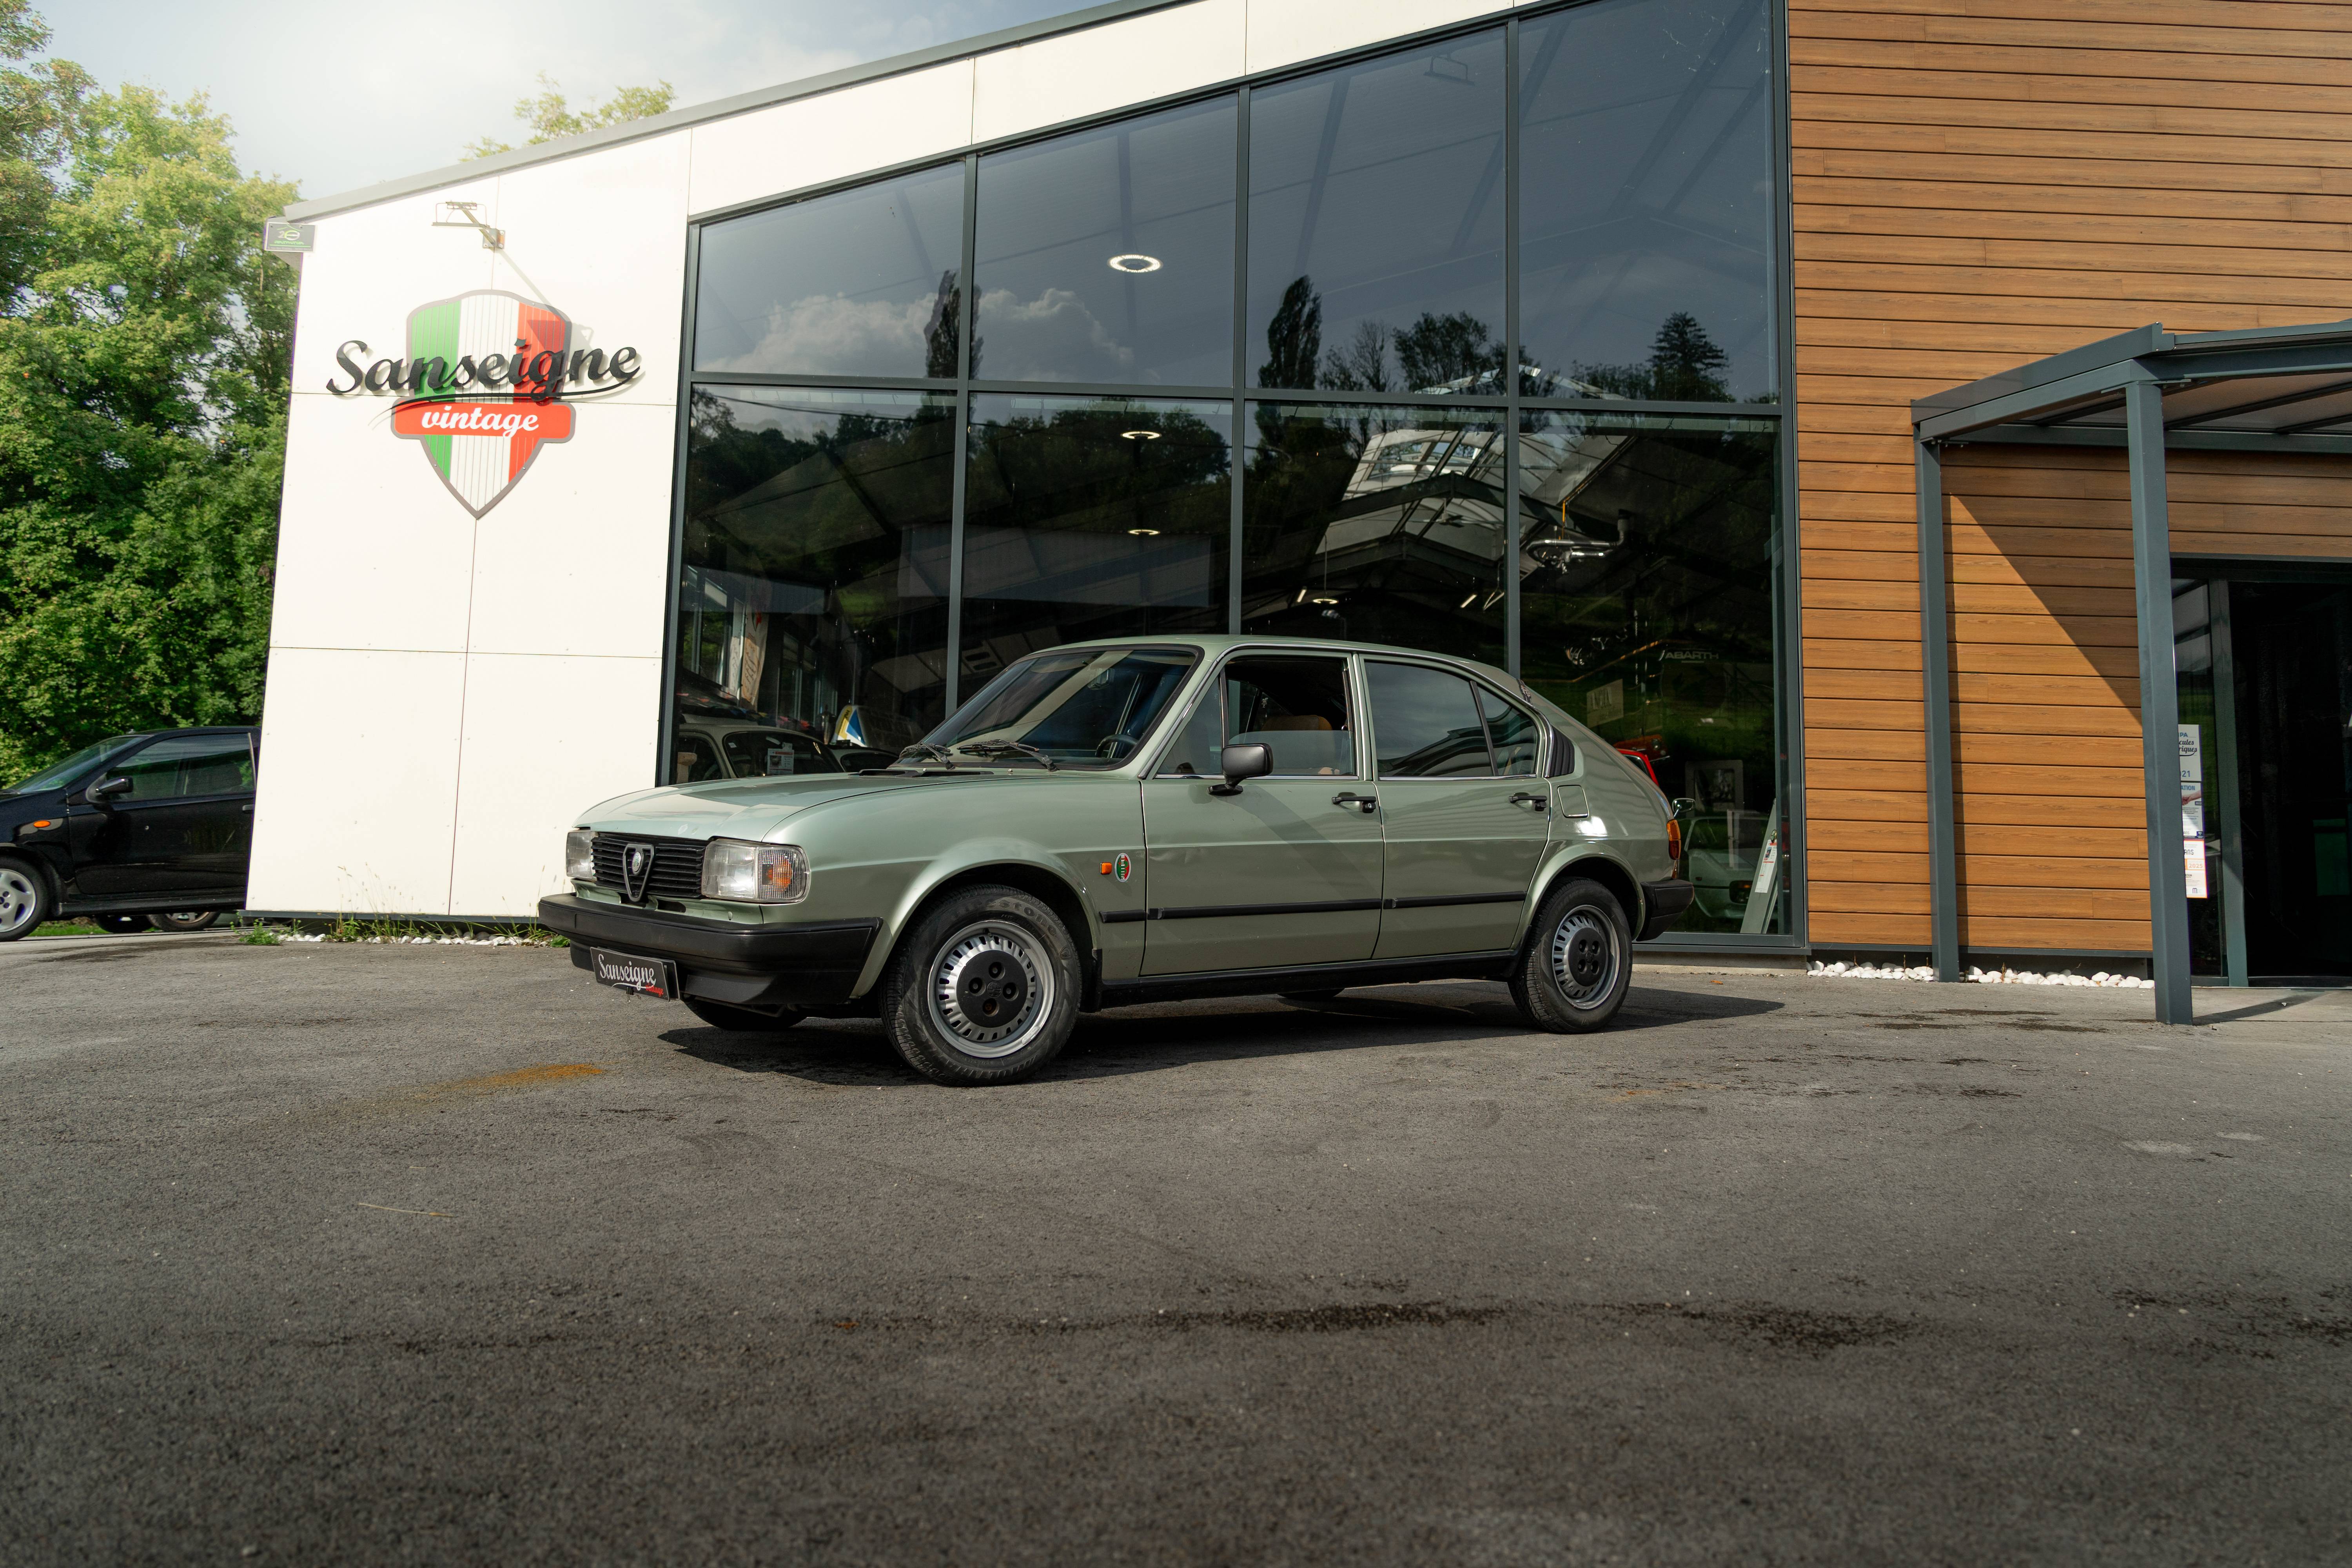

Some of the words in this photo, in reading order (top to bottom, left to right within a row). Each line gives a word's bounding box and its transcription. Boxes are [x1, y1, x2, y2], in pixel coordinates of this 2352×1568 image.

[326, 339, 641, 404] Sanseigne
[421, 406, 540, 438] vintage
[1665, 651, 1719, 659] ABARTH
[598, 953, 656, 991] Sanseigne
[646, 983, 664, 997] vintage
